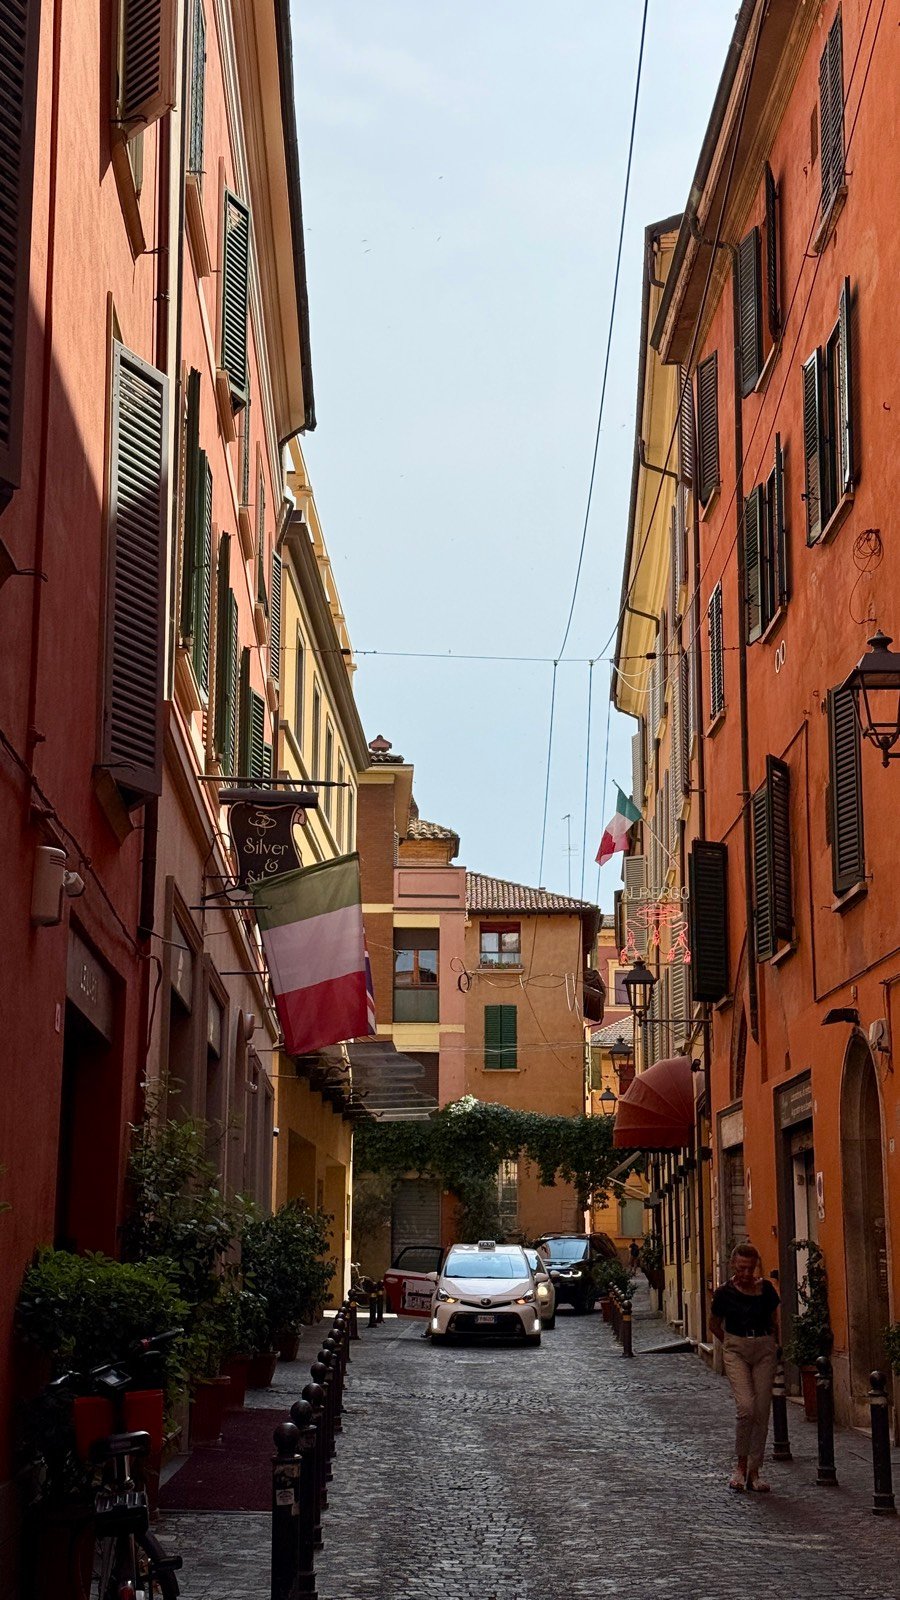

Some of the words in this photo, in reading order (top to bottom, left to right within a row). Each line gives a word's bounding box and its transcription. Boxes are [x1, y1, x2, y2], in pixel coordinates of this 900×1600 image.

[243, 837, 289, 856] Silver
[264, 858, 279, 873] &
[621, 886, 690, 900] ALBERGO
